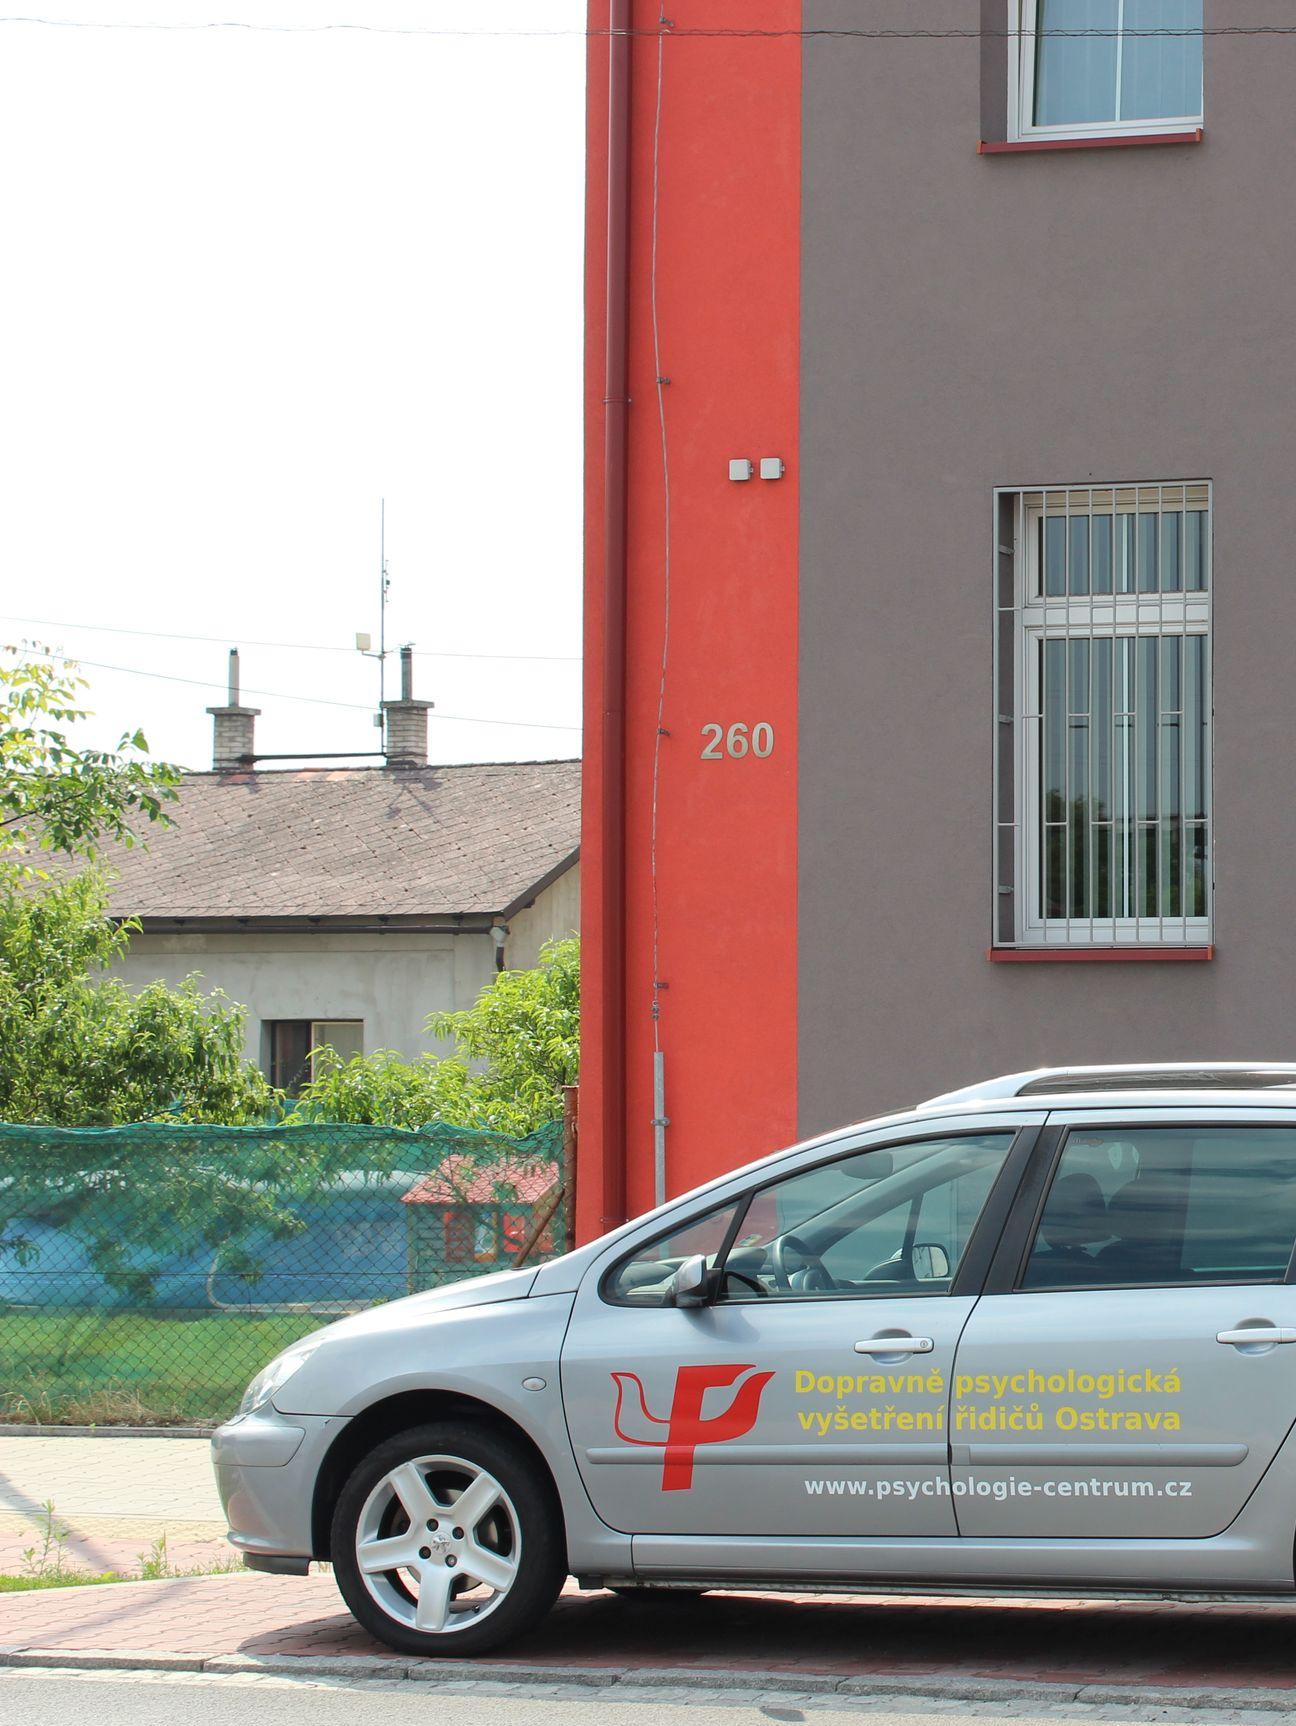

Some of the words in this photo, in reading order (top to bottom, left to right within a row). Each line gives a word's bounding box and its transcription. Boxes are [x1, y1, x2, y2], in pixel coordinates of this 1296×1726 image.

[700, 722, 775, 760] 260
[794, 1368, 945, 1399] Dopravně
[955, 1368, 1181, 1399] psychologická
[797, 1405, 944, 1436] vyšetření
[955, 1403, 1044, 1431] řidičů
[1055, 1406, 1181, 1431] Ostrava
[804, 1476, 1193, 1500] www.psychologie-centrum.cz
